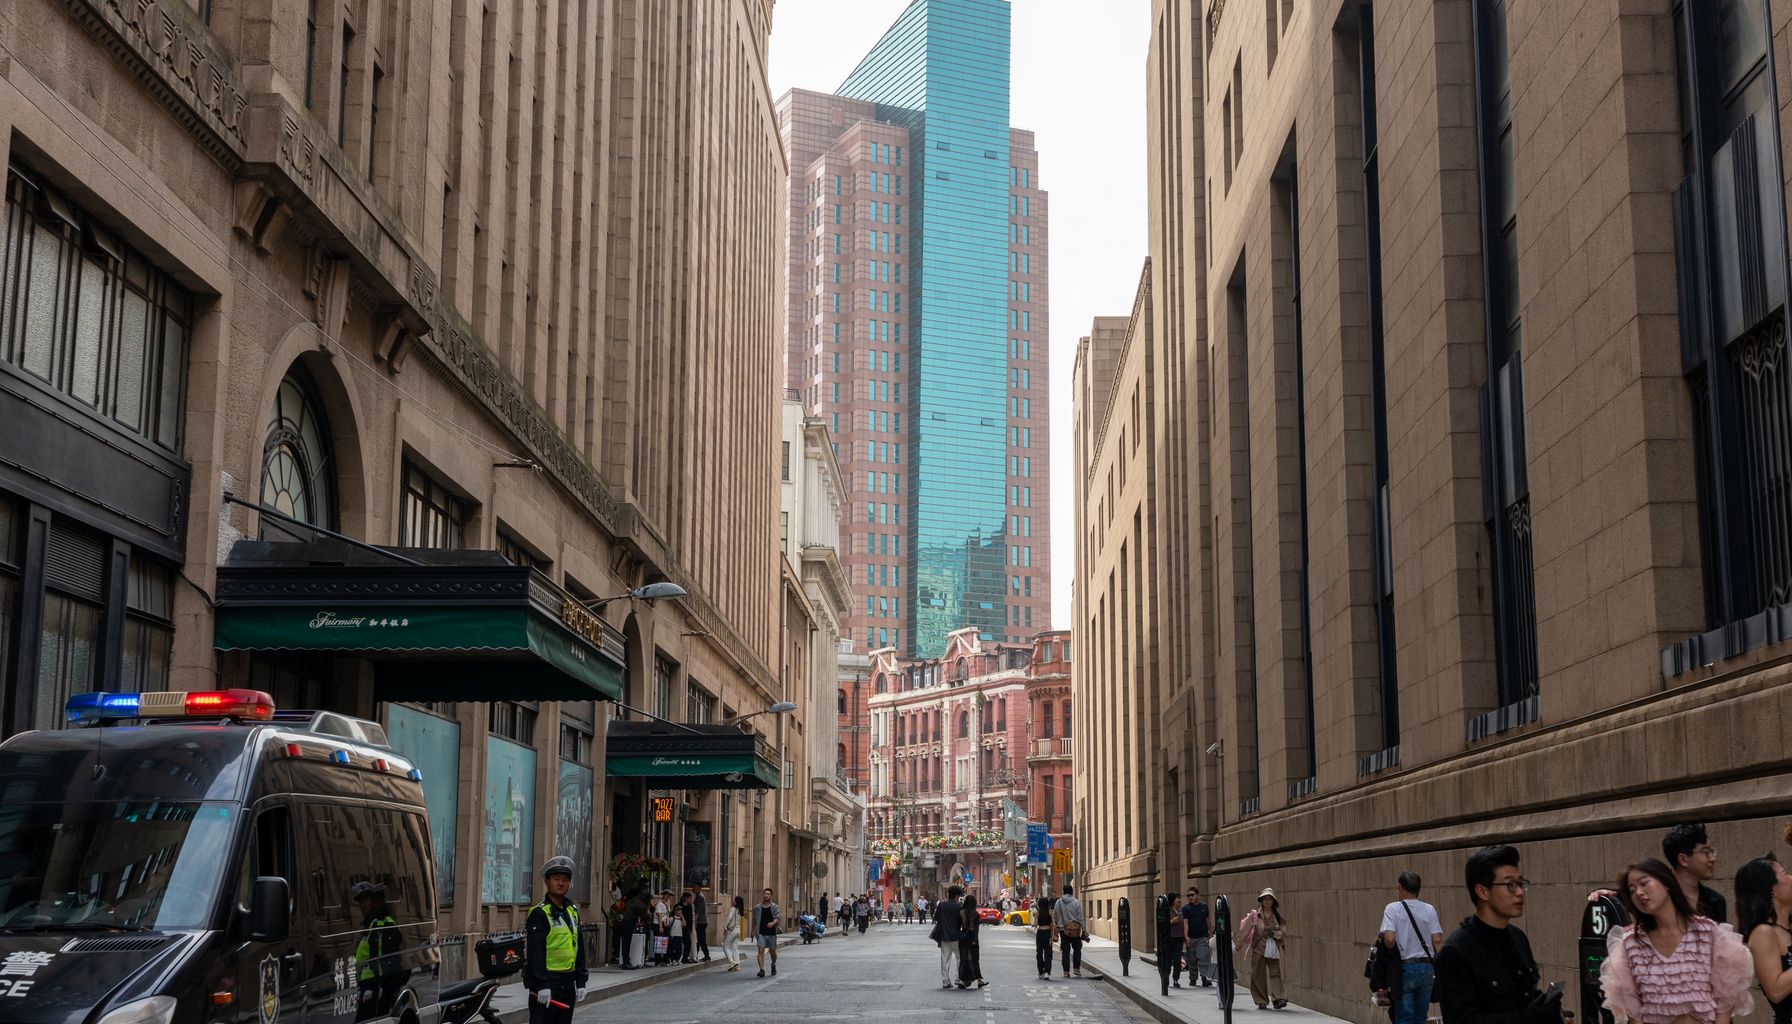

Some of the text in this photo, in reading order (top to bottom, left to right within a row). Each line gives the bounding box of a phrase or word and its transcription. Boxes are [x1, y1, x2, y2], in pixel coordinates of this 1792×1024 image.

[310, 611, 366, 629] Fairmont
[655, 798, 673, 810] JAZZ
[655, 809, 671, 821] BAR
[0, 951, 56, 976] 警
[333, 993, 359, 1016] POLICE
